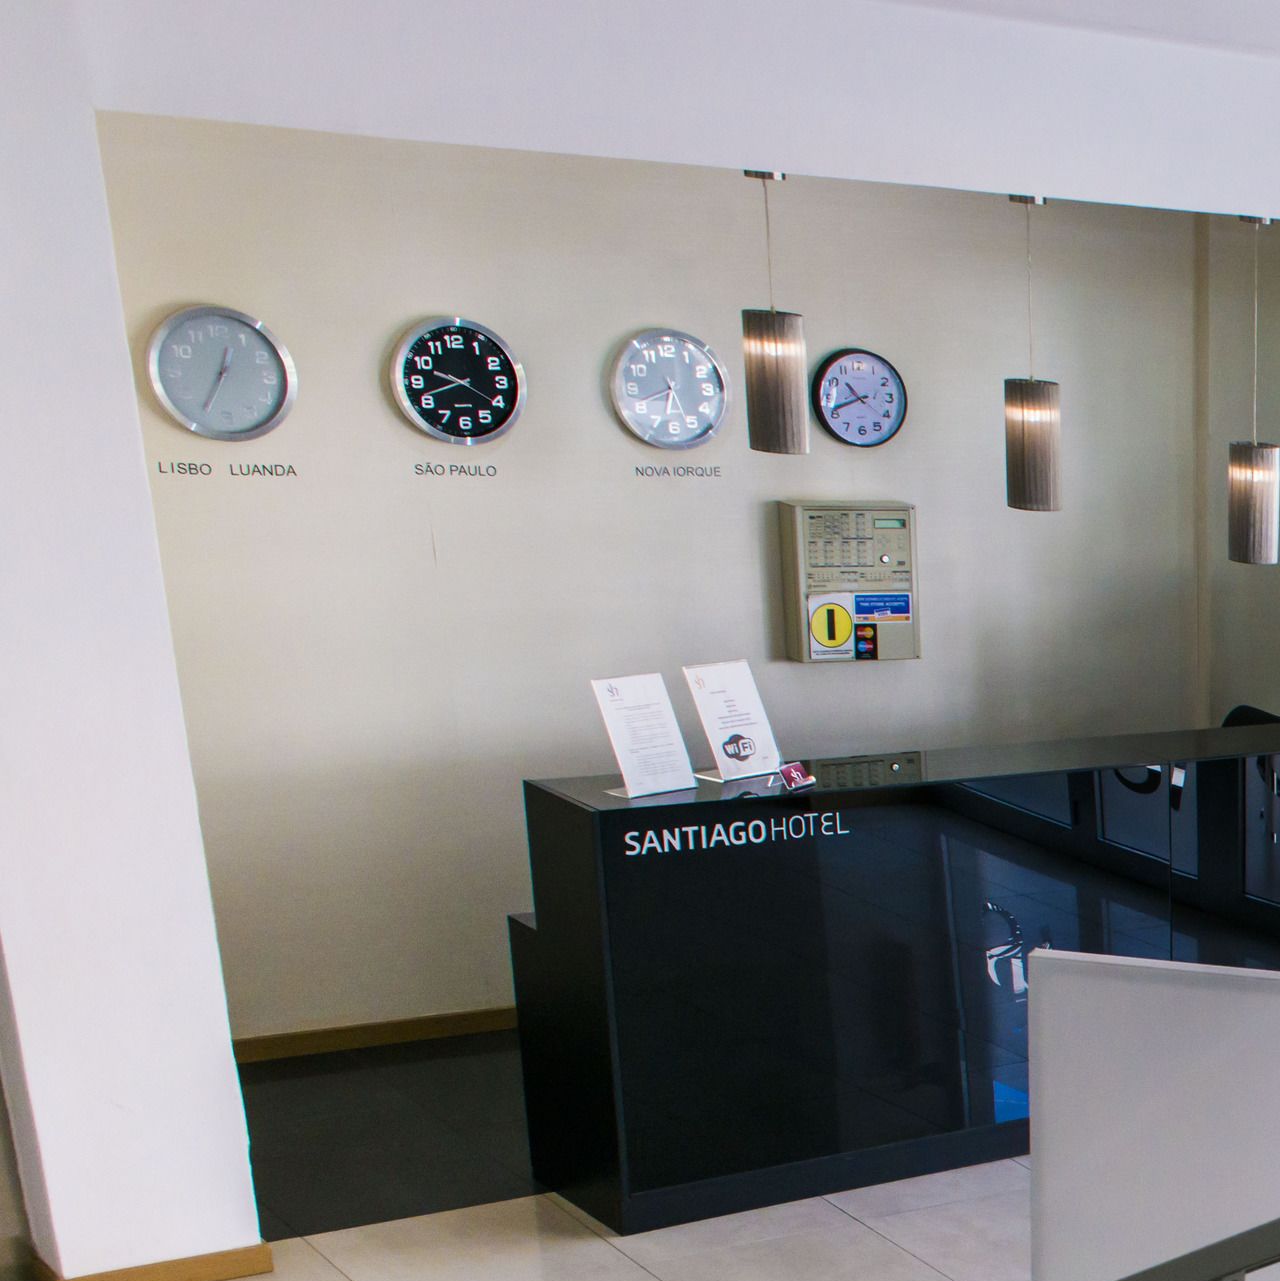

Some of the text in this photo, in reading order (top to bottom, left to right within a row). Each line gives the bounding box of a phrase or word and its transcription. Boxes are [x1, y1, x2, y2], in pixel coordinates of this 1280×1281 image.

[239, 334, 246, 345] 1
[443, 335, 464, 348] 12
[171, 345, 192, 358] 10
[428, 341, 442, 355] 11
[472, 341, 480, 355] 1
[657, 345, 676, 357] 12
[256, 351, 269, 364] 2
[414, 356, 433, 369] 10
[642, 350, 656, 363] 11
[683, 351, 690, 364] 1
[487, 357, 501, 370] 2
[630, 364, 647, 376] 10
[696, 366, 708, 378] 2
[840, 366, 847, 375] 11
[410, 375, 424, 389] 9
[494, 376, 508, 389] 3
[627, 382, 638, 395] 9
[880, 377, 889, 387] 2
[702, 383, 714, 396] 3
[421, 396, 435, 408] 8
[491, 395, 505, 408] 4
[885, 393, 893, 403] 3
[635, 401, 647, 414] 8
[699, 402, 710, 414] 4
[438, 410, 451, 423] 7
[478, 410, 492, 423] 5
[882, 410, 891, 419] 4
[459, 416, 473, 430] 6
[651, 416, 662, 428] 7
[669, 422, 680, 434] 6
[685, 416, 698, 428] 5
[843, 422, 850, 432] 7
[873, 422, 882, 432] 5
[858, 426, 867, 436] 6
[158, 462, 297, 477] LISBO LUANDA
[414, 462, 497, 477] SÃO PAULO
[635, 466, 722, 478] NOVA IORQUE
